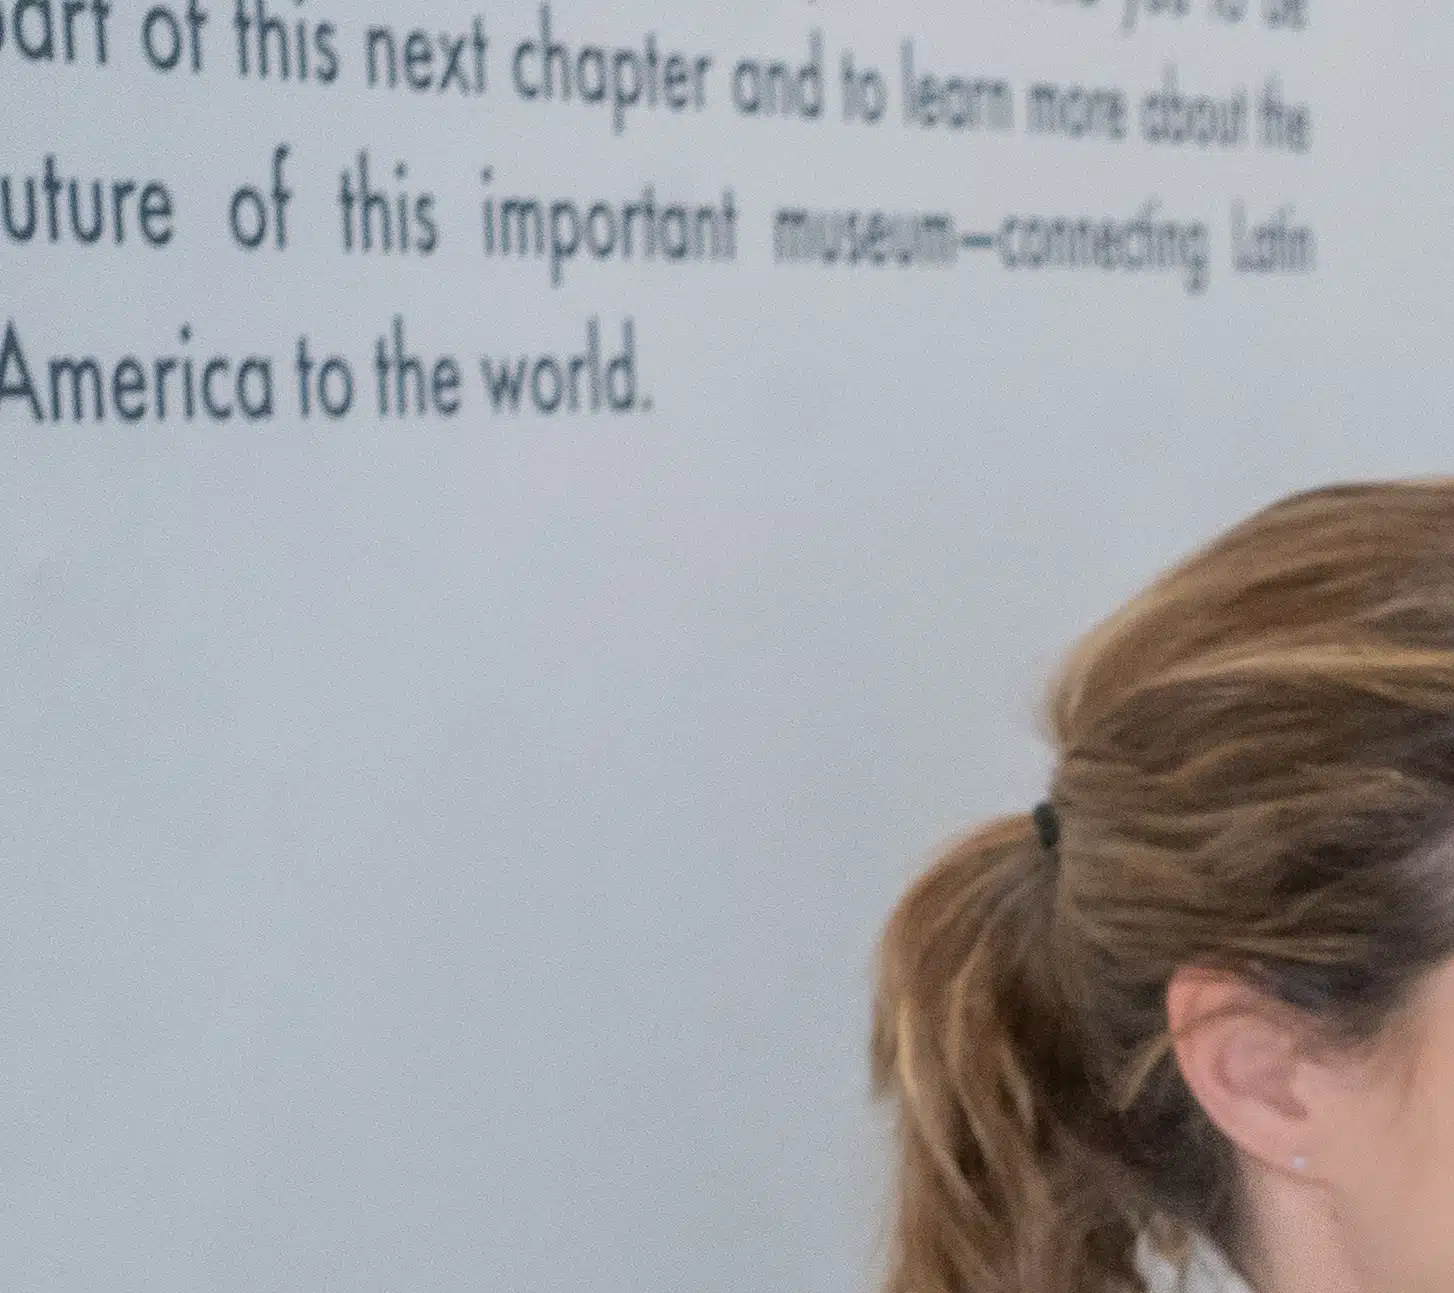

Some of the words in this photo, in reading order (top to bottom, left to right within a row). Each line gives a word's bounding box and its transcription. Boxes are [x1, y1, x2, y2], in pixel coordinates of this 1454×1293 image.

[0, 0, 108, 66] art
[142, 0, 207, 74] of
[234, 0, 340, 84] this
[366, 14, 490, 96] next
[512, 2, 712, 136] chapter
[732, 28, 826, 122] and
[842, 48, 888, 124] to
[902, 36, 1014, 132] learn
[1027, 80, 1128, 142] more
[1140, 62, 1248, 150] about
[1258, 70, 1312, 154] the
[229, 142, 292, 250] of
[339, 148, 438, 256] this
[480, 164, 738, 290] important
[1230, 198, 1316, 274] Latin
[0, 318, 273, 424] America
[296, 334, 353, 420] to
[375, 314, 463, 416] the
[480, 315, 653, 416] world.
